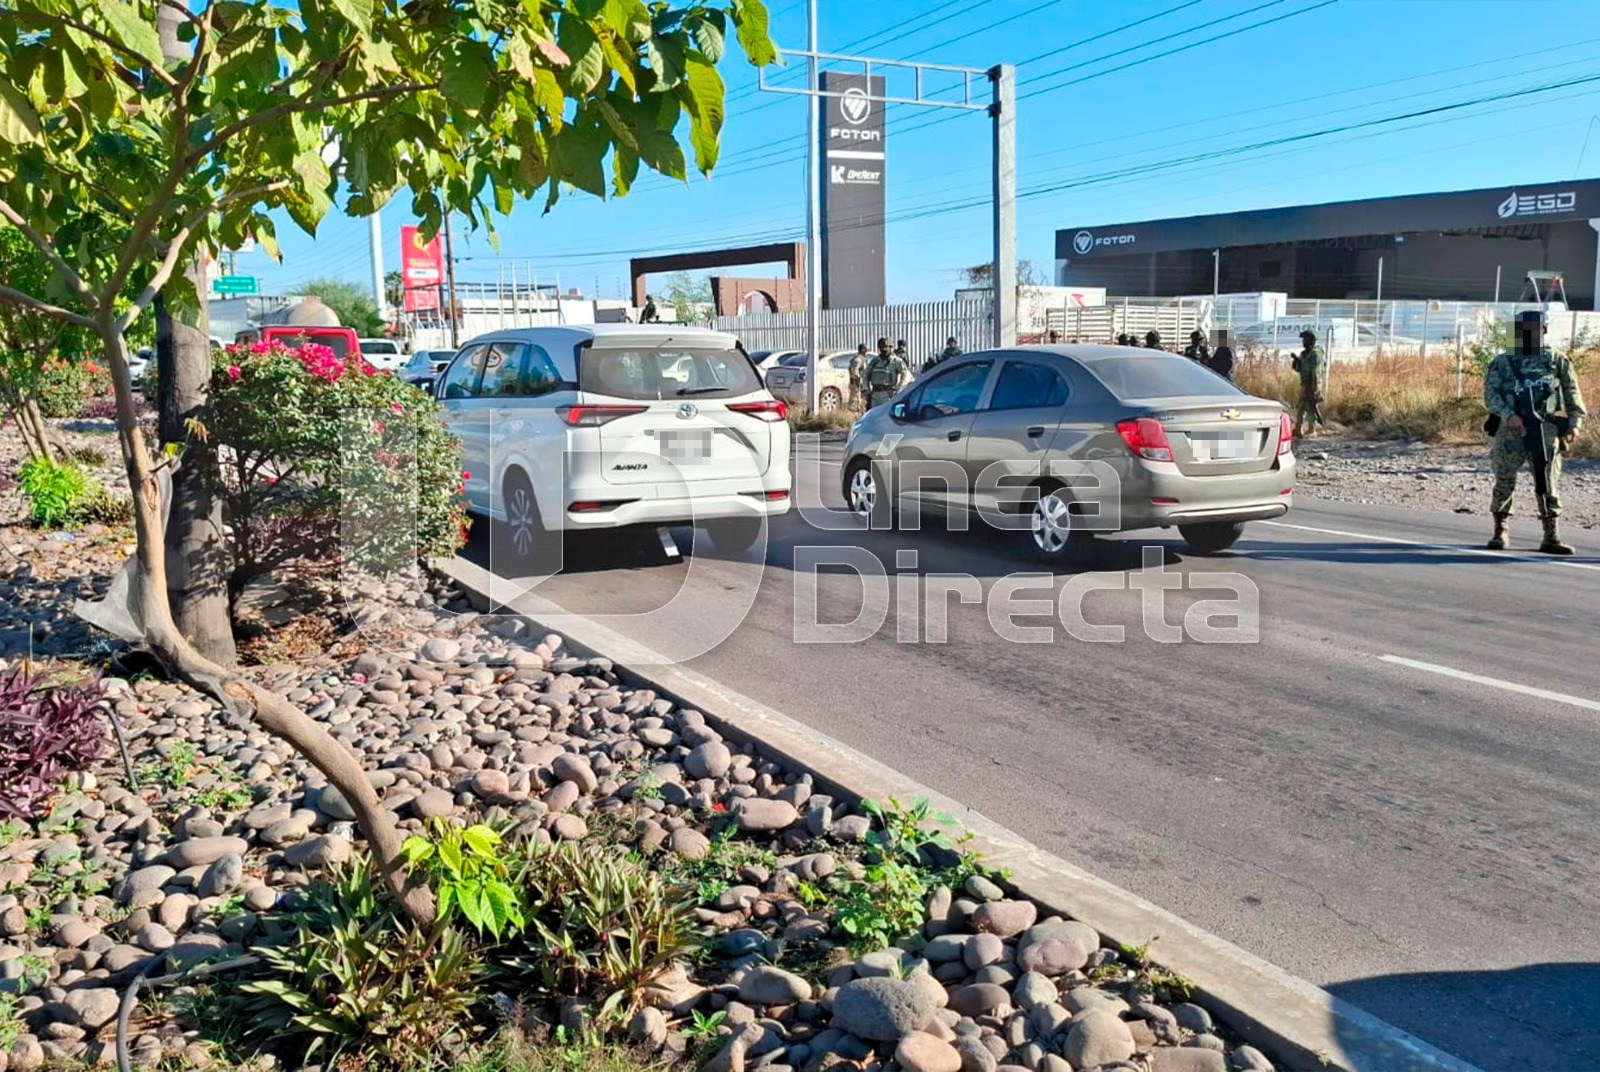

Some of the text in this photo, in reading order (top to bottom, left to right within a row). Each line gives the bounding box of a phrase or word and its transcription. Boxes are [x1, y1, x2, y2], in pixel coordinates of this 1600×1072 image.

[830, 128, 880, 141] FOTON
[1518, 192, 1576, 211] EGO
[1095, 234, 1135, 246] FOTON
